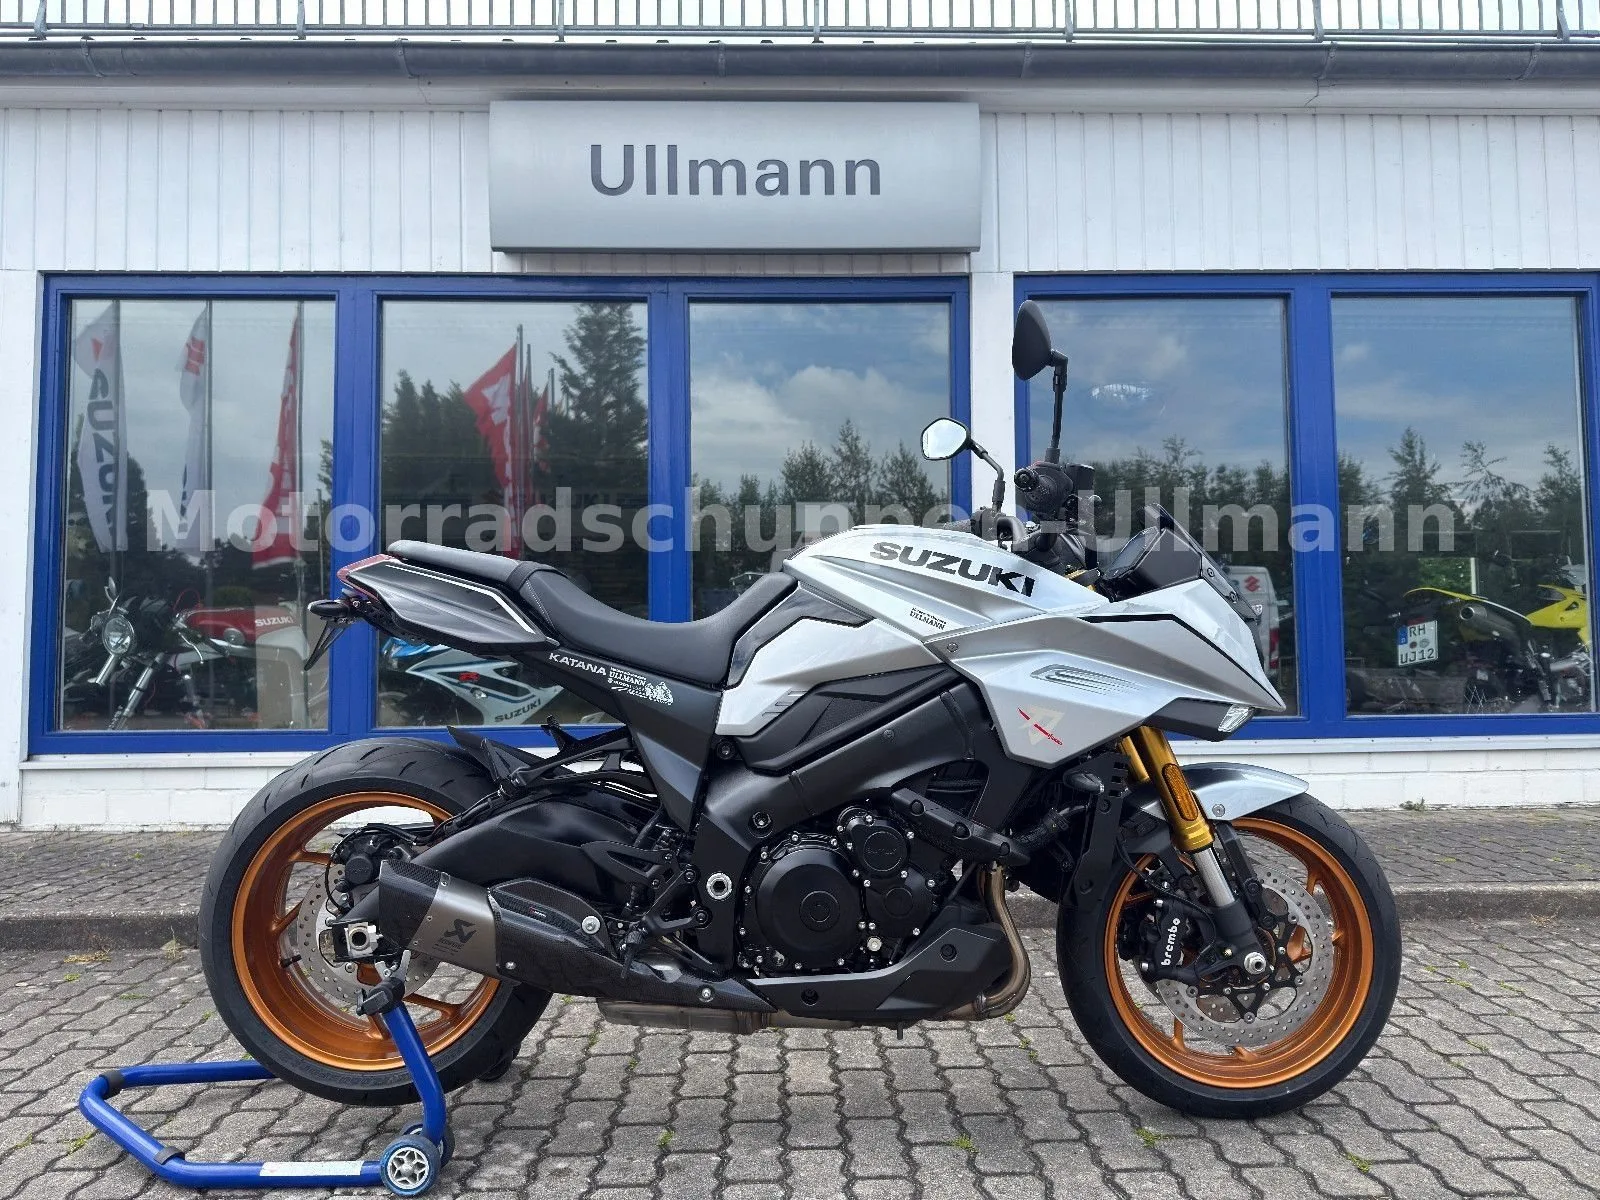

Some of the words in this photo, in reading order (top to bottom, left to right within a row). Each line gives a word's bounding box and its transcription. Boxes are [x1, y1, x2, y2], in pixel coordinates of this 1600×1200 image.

[590, 144, 881, 197] Ullmann
[869, 541, 1036, 598] SUZUKI
[254, 616, 295, 628] SUZUKI
[909, 610, 946, 630] ULLMANN
[1409, 623, 1427, 637] RH
[548, 653, 607, 676] KATANA
[609, 671, 647, 687] ULLMANN
[494, 699, 542, 723] SUZUKI
[1160, 917, 1181, 966] brembo
